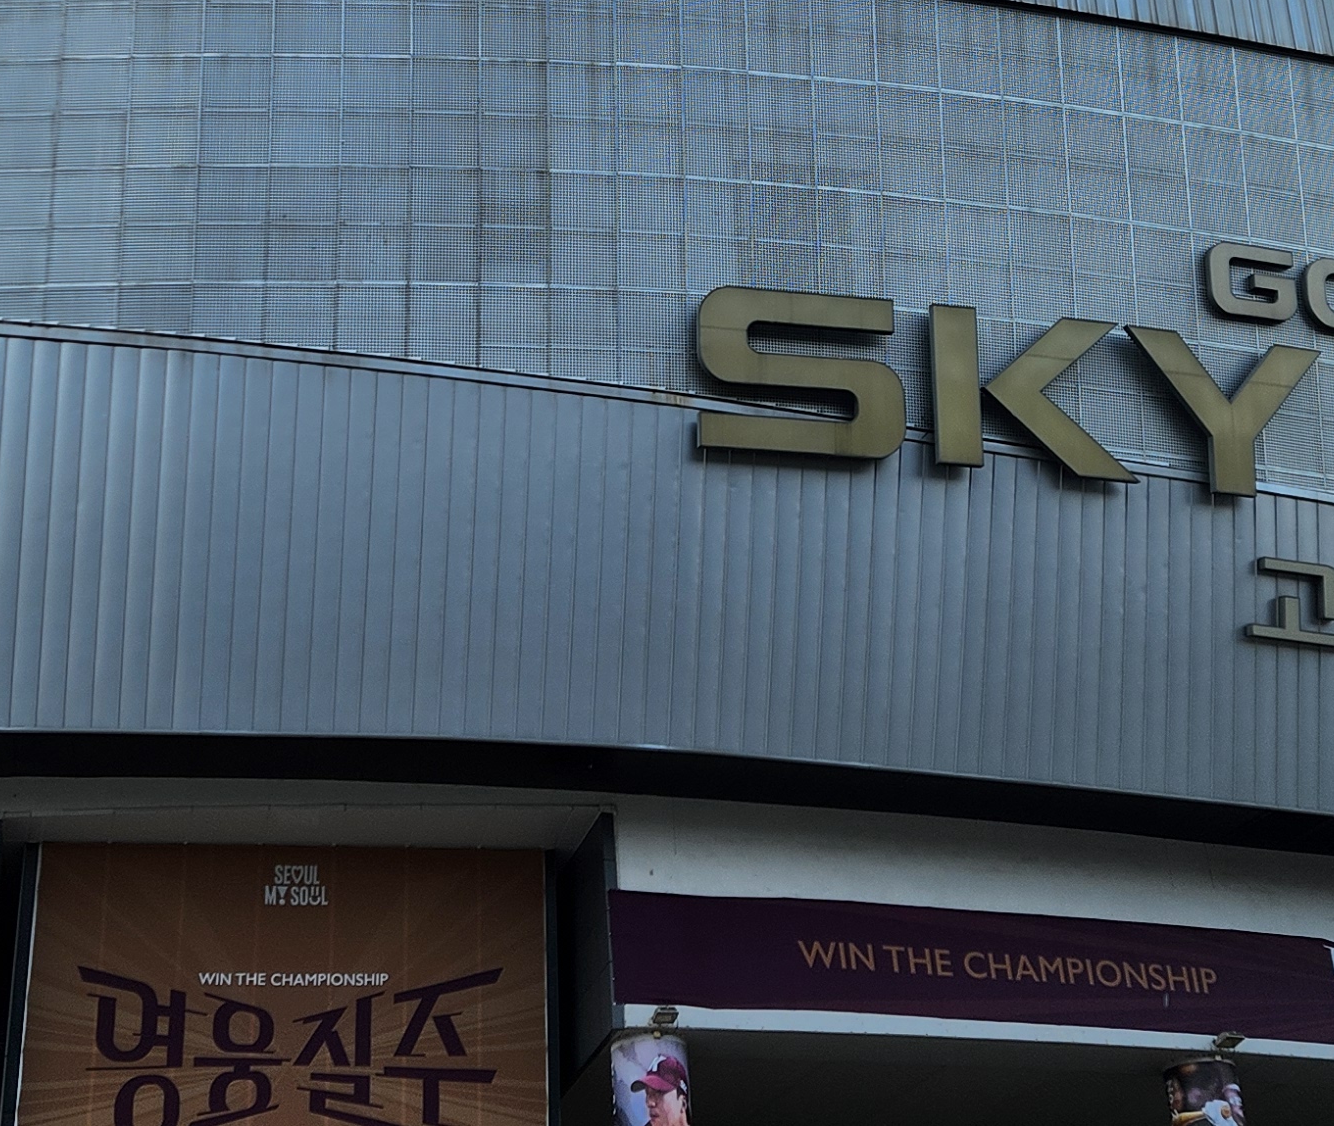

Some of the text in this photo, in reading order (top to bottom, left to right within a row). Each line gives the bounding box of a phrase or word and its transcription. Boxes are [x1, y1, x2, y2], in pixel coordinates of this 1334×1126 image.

[696, 284, 1321, 499] SKY
[290, 885, 329, 906] SOUL
[199, 972, 389, 987] WIN THE CHAMPIONSHIP
[797, 940, 1217, 995] WIN THE CHAMPIONSHIP
[78, 967, 505, 1126] 영웅질주
